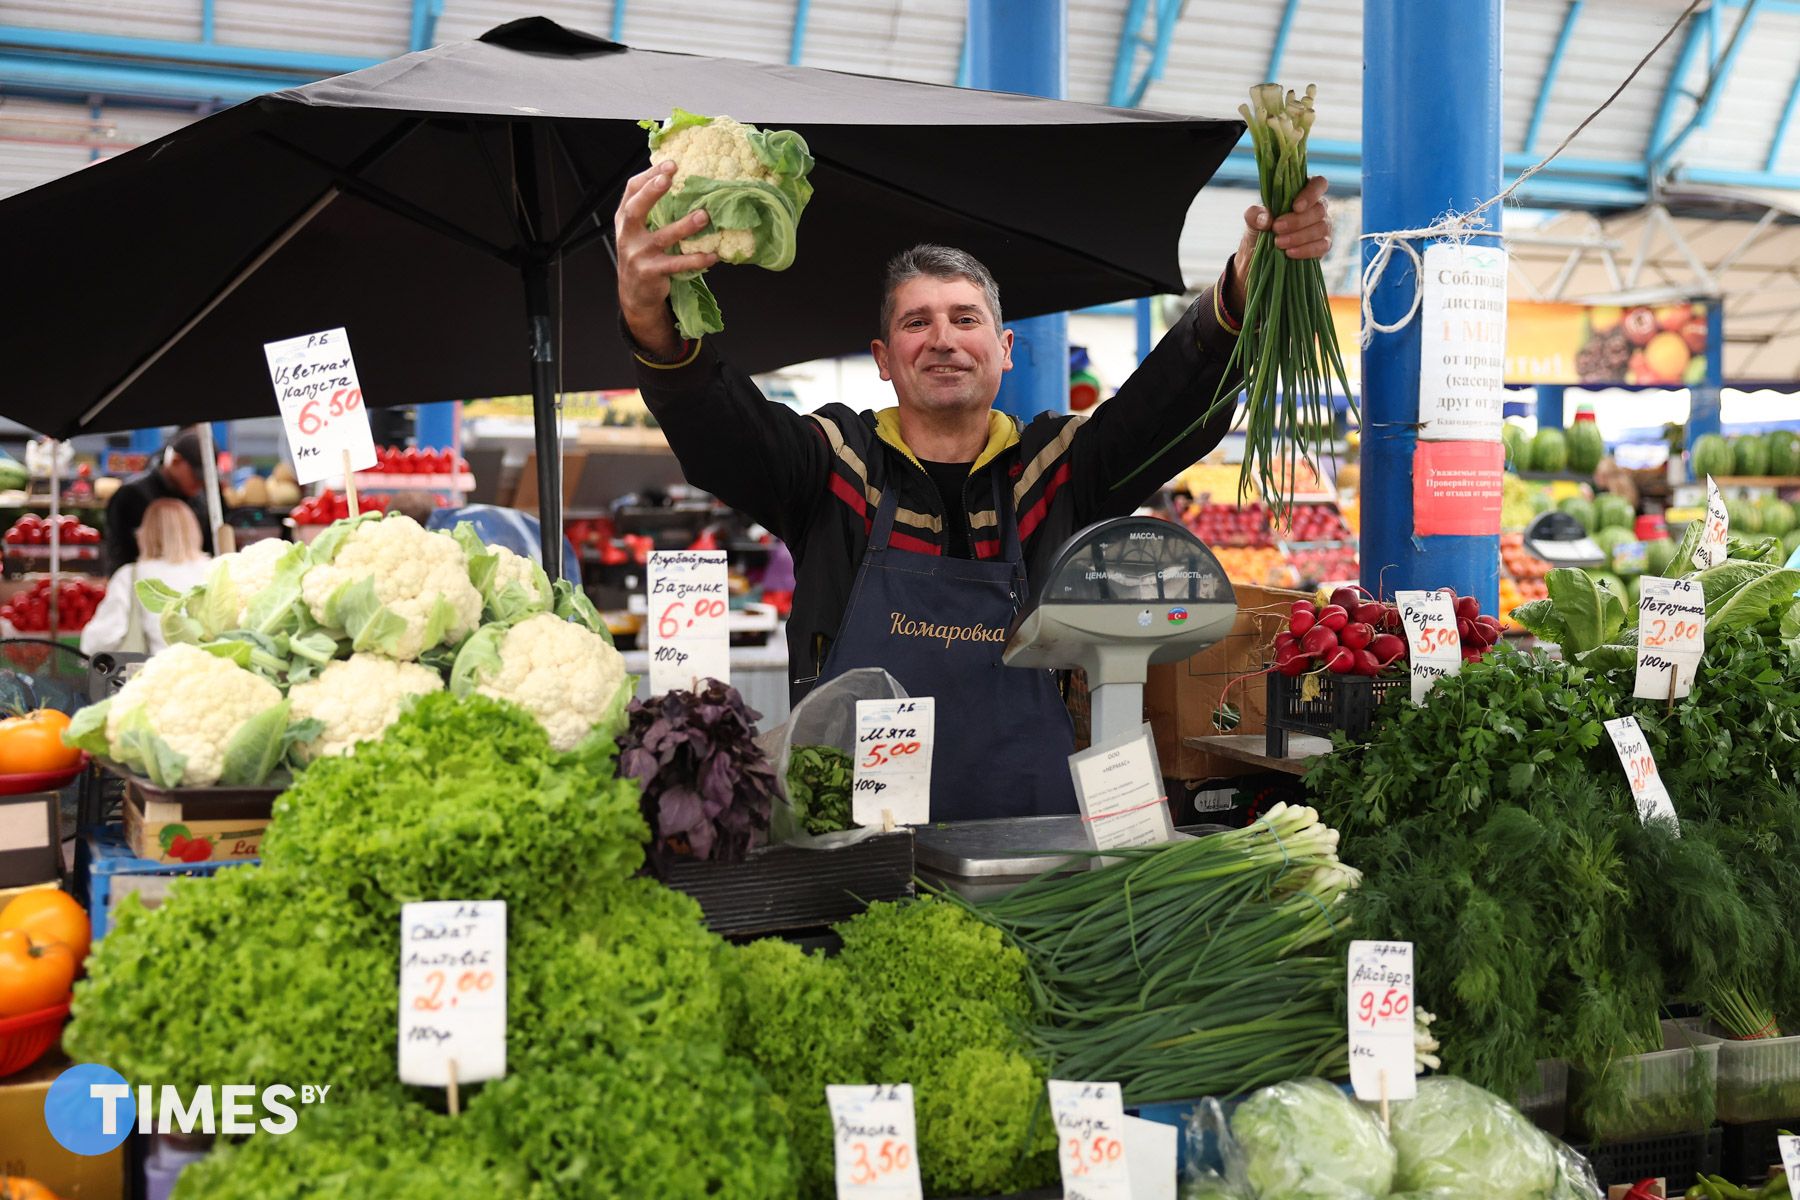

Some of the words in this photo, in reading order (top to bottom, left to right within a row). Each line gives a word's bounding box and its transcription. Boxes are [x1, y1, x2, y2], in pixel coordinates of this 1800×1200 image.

[1443, 355, 1459, 366] от
[1436, 397, 1470, 411] друг
[652, 577, 724, 599] Базилик
[1404, 606, 1444, 631] Редис
[890, 612, 1006, 649] Комаровка
[860, 727, 917, 743] Мята
